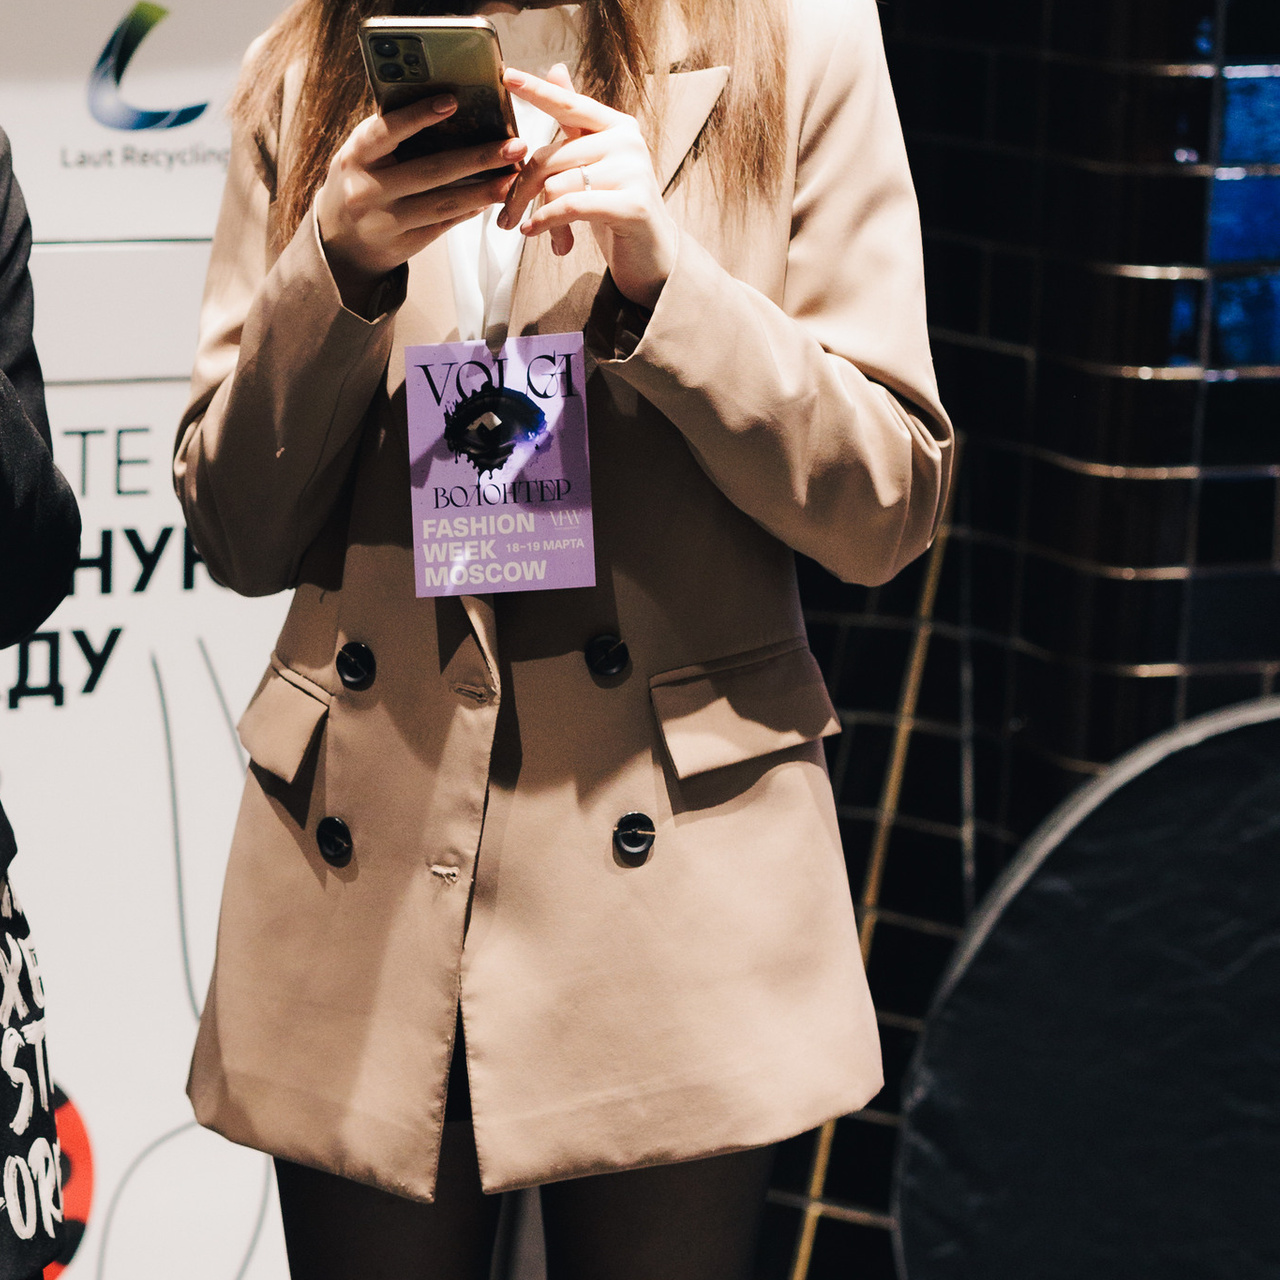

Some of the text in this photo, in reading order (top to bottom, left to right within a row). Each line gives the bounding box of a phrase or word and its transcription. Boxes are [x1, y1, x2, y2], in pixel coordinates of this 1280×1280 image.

[61, 146, 115, 169] Laut
[423, 512, 536, 539] FASHION
[423, 540, 497, 563] WEEK
[425, 560, 547, 587] MOSCOW
[1, 1019, 55, 1135] ST
